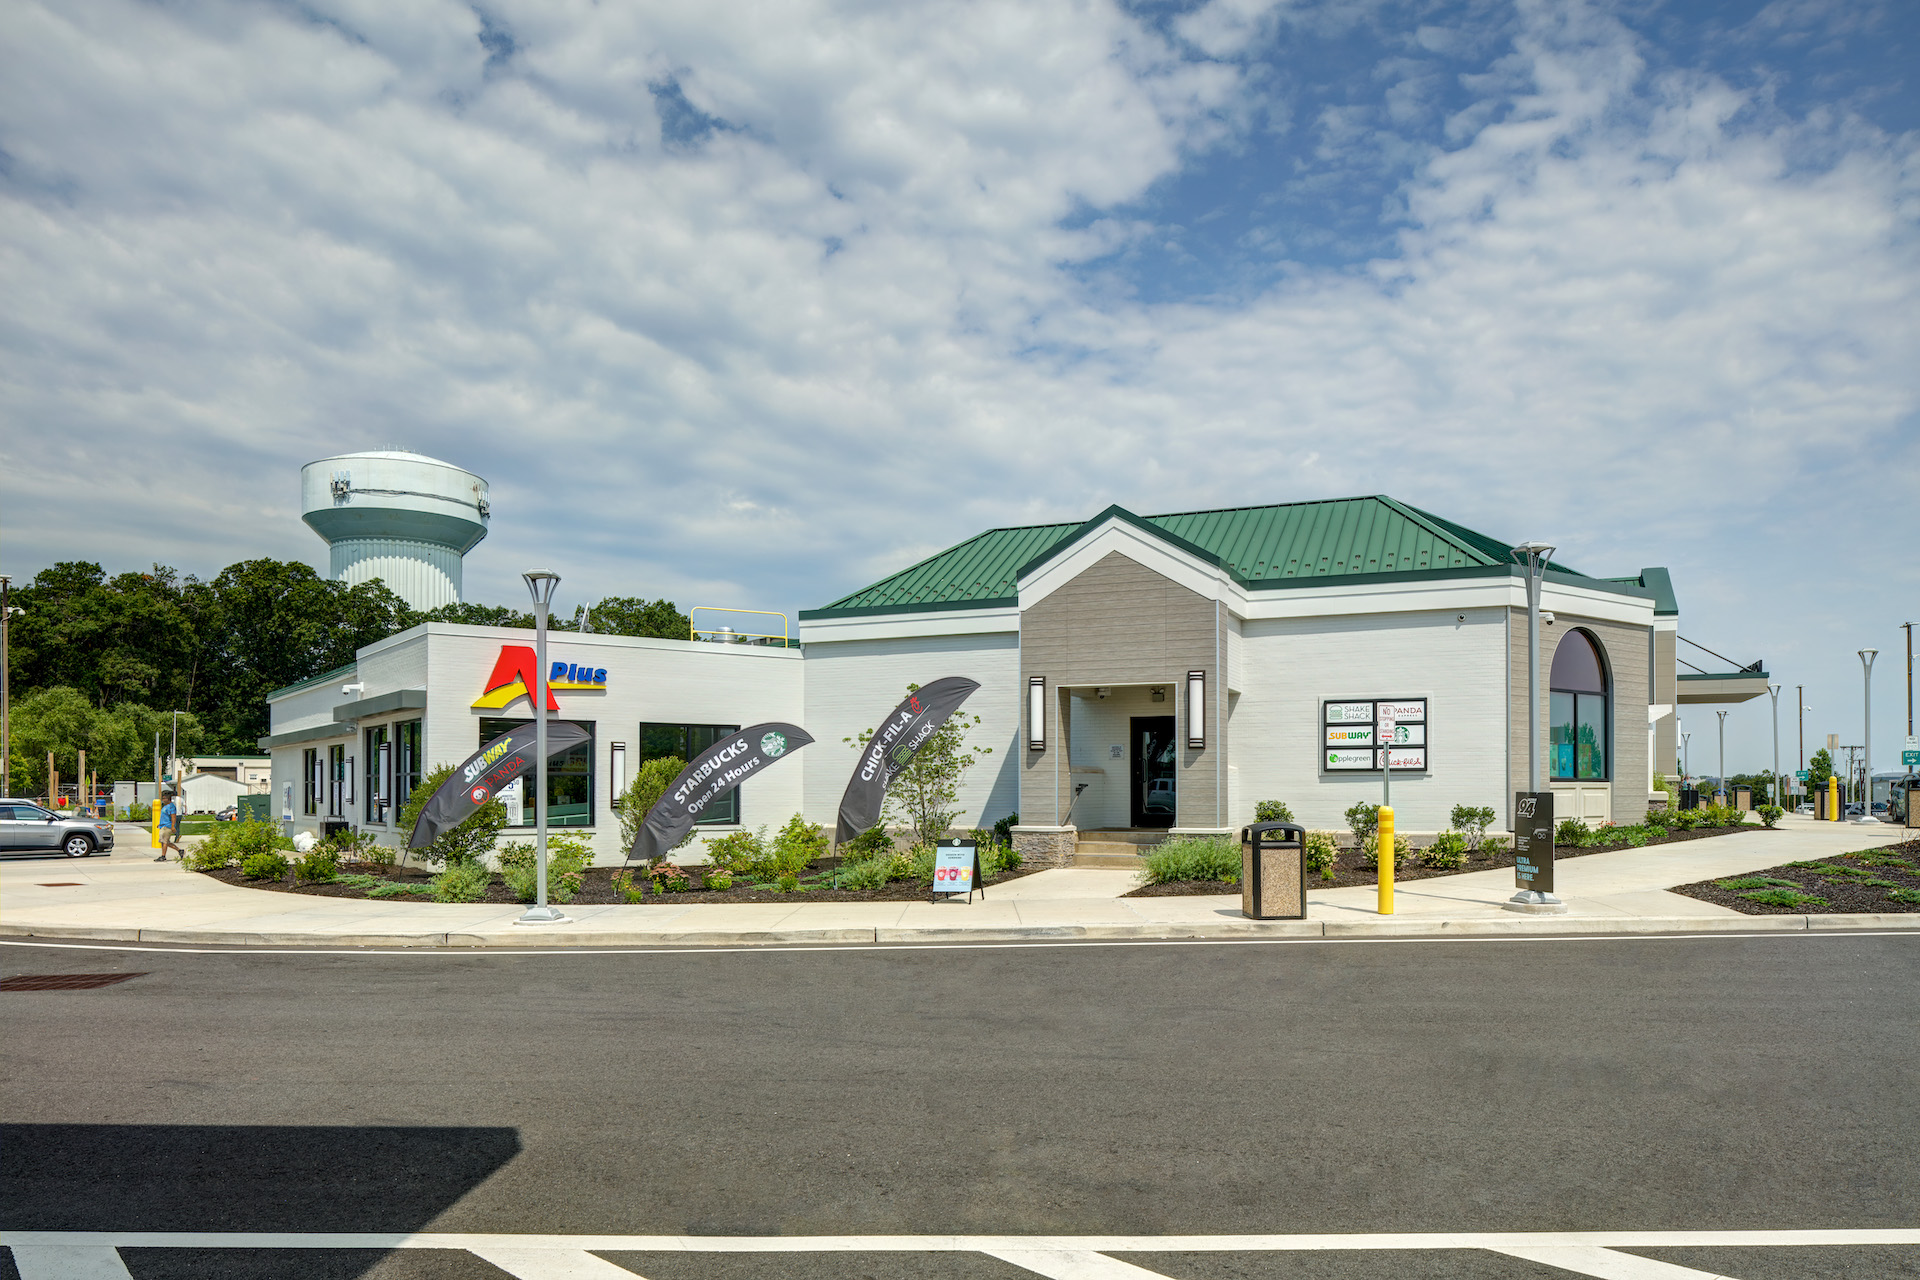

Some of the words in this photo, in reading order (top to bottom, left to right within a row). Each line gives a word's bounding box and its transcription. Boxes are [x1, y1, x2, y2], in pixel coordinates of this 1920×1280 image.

[549, 661, 608, 683] Plus
[1344, 705, 1370, 713] SHAKE
[1344, 712, 1371, 720] SHACK
[908, 719, 936, 751] SHACK
[1328, 731, 1371, 740] SUBWAY
[861, 711, 913, 782] CHICK-FIL-A
[464, 736, 513, 783] SUBWAY
[485, 756, 526, 787] PANDA
[674, 738, 749, 804] STARBUCKS
[687, 789, 713, 814] Open
[711, 777, 726, 794] 24
[724, 756, 760, 783] Hours
[1516, 798, 1537, 818] 94
[1516, 856, 1531, 865] ULTRA
[1516, 864, 1539, 874] PREMIUM
